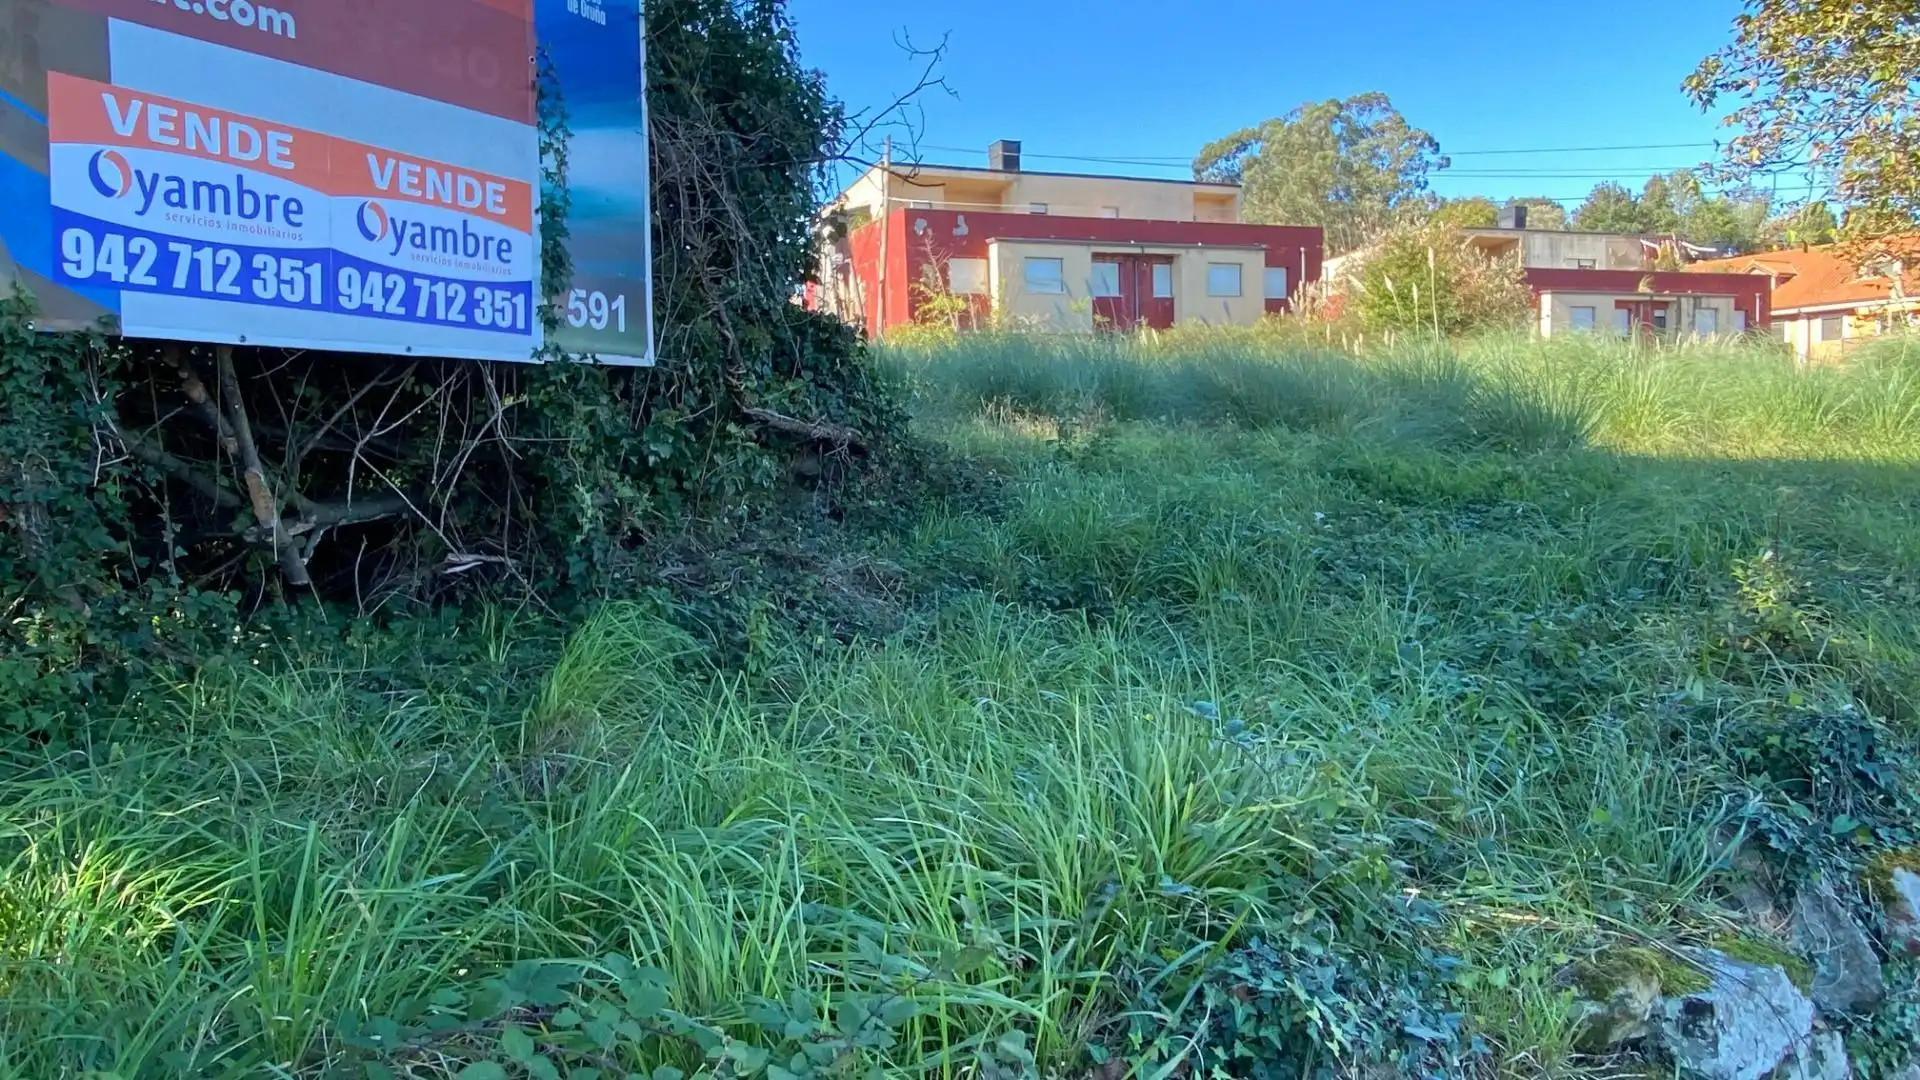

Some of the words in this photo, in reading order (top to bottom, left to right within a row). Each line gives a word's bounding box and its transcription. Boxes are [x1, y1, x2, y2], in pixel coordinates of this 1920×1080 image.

[151, 0, 296, 39] .com
[101, 93, 296, 170] VENDE
[88, 149, 304, 228] Oyambre
[366, 153, 506, 215] VENDE
[165, 211, 222, 229] servicios
[226, 221, 303, 242] inmobiliarios
[356, 200, 513, 265] Oyambre
[61, 227, 157, 286] 942
[168, 241, 242, 295] 712
[252, 253, 322, 305] 351
[411, 253, 452, 267] servicios
[455, 258, 512, 276] inmobiliarios
[337, 267, 406, 315] 942
[413, 278, 467, 322] 712
[474, 286, 526, 330] 351
[567, 289, 625, 333] 591
